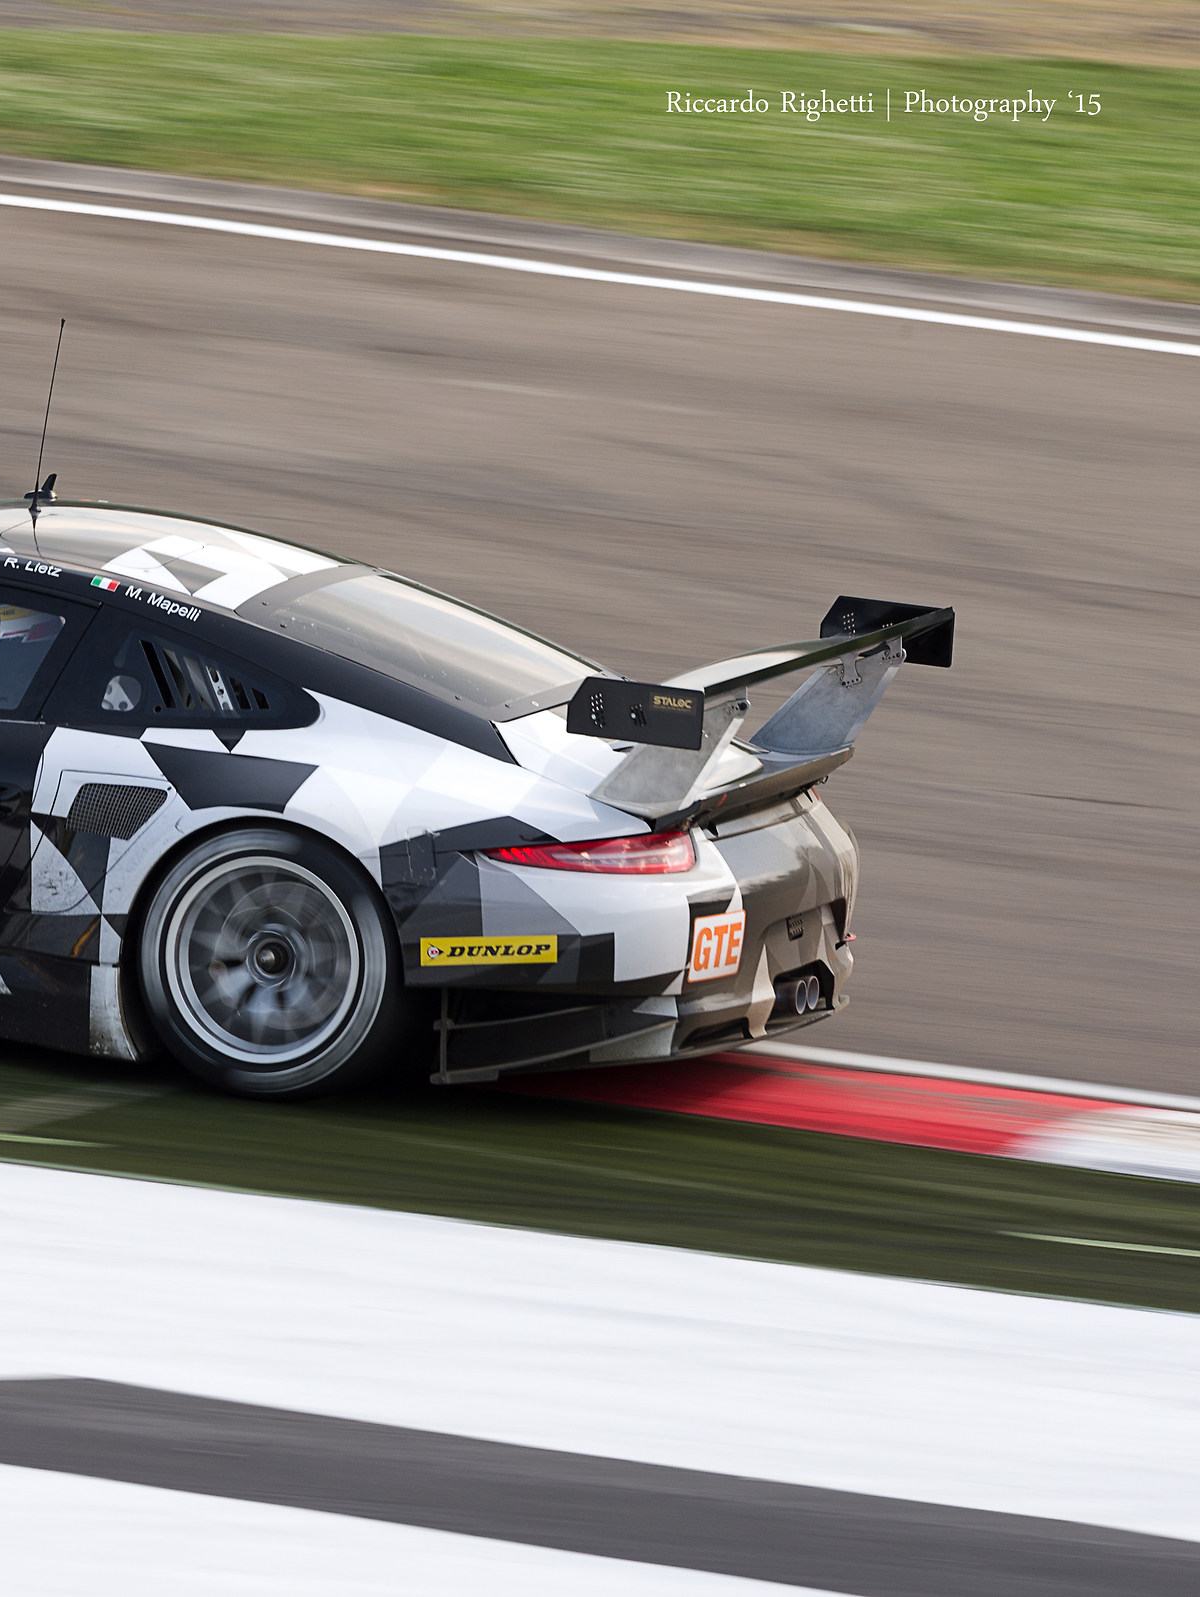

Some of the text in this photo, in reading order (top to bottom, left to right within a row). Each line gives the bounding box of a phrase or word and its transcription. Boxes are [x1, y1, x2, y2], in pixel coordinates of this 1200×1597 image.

[3, 556, 63, 578] R. Lietz
[125, 585, 202, 622] M. Mapelli
[653, 695, 692, 709] STALOC
[446, 944, 551, 958] DUNLOP
[693, 922, 743, 973] GTE
